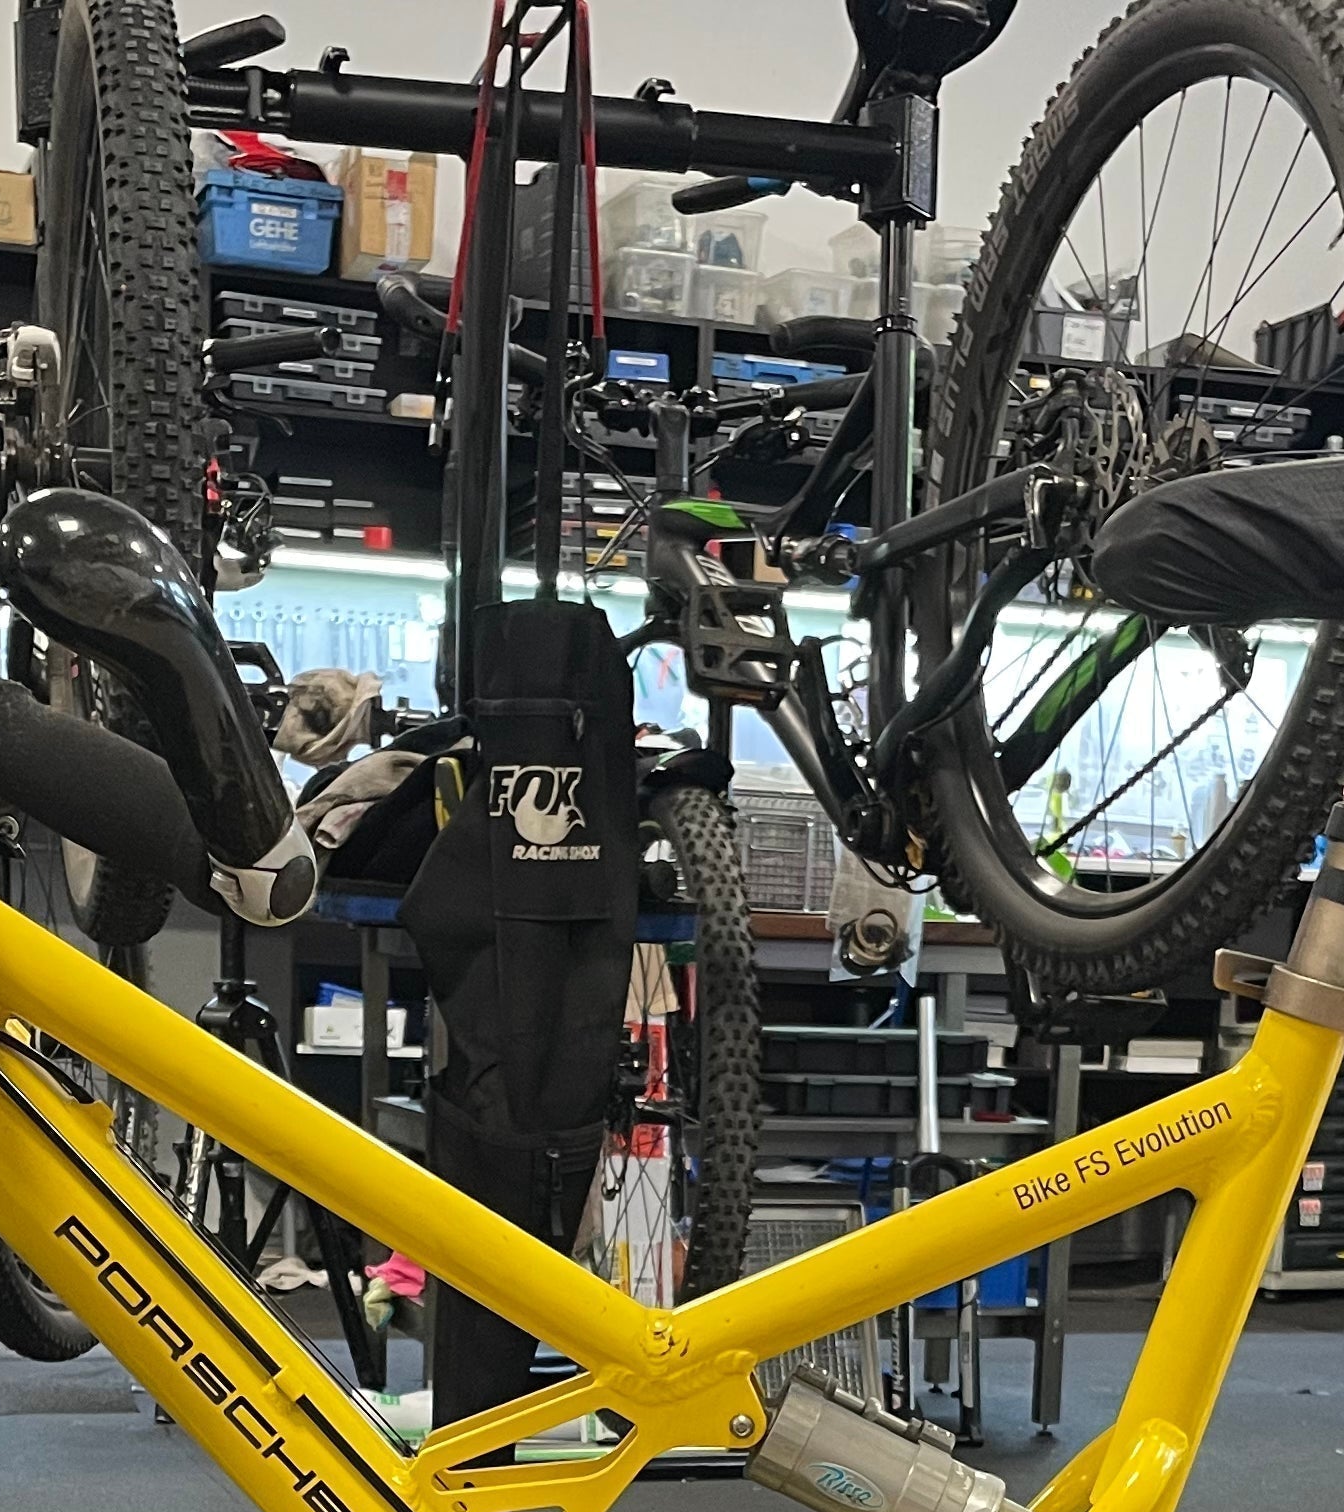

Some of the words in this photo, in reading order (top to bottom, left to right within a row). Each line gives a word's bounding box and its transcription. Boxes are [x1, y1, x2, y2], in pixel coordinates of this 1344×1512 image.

[489, 765, 585, 827] FOX
[1013, 1172, 1071, 1210] Bike
[1074, 1150, 1110, 1184] FS
[1114, 1101, 1233, 1166] Evolution
